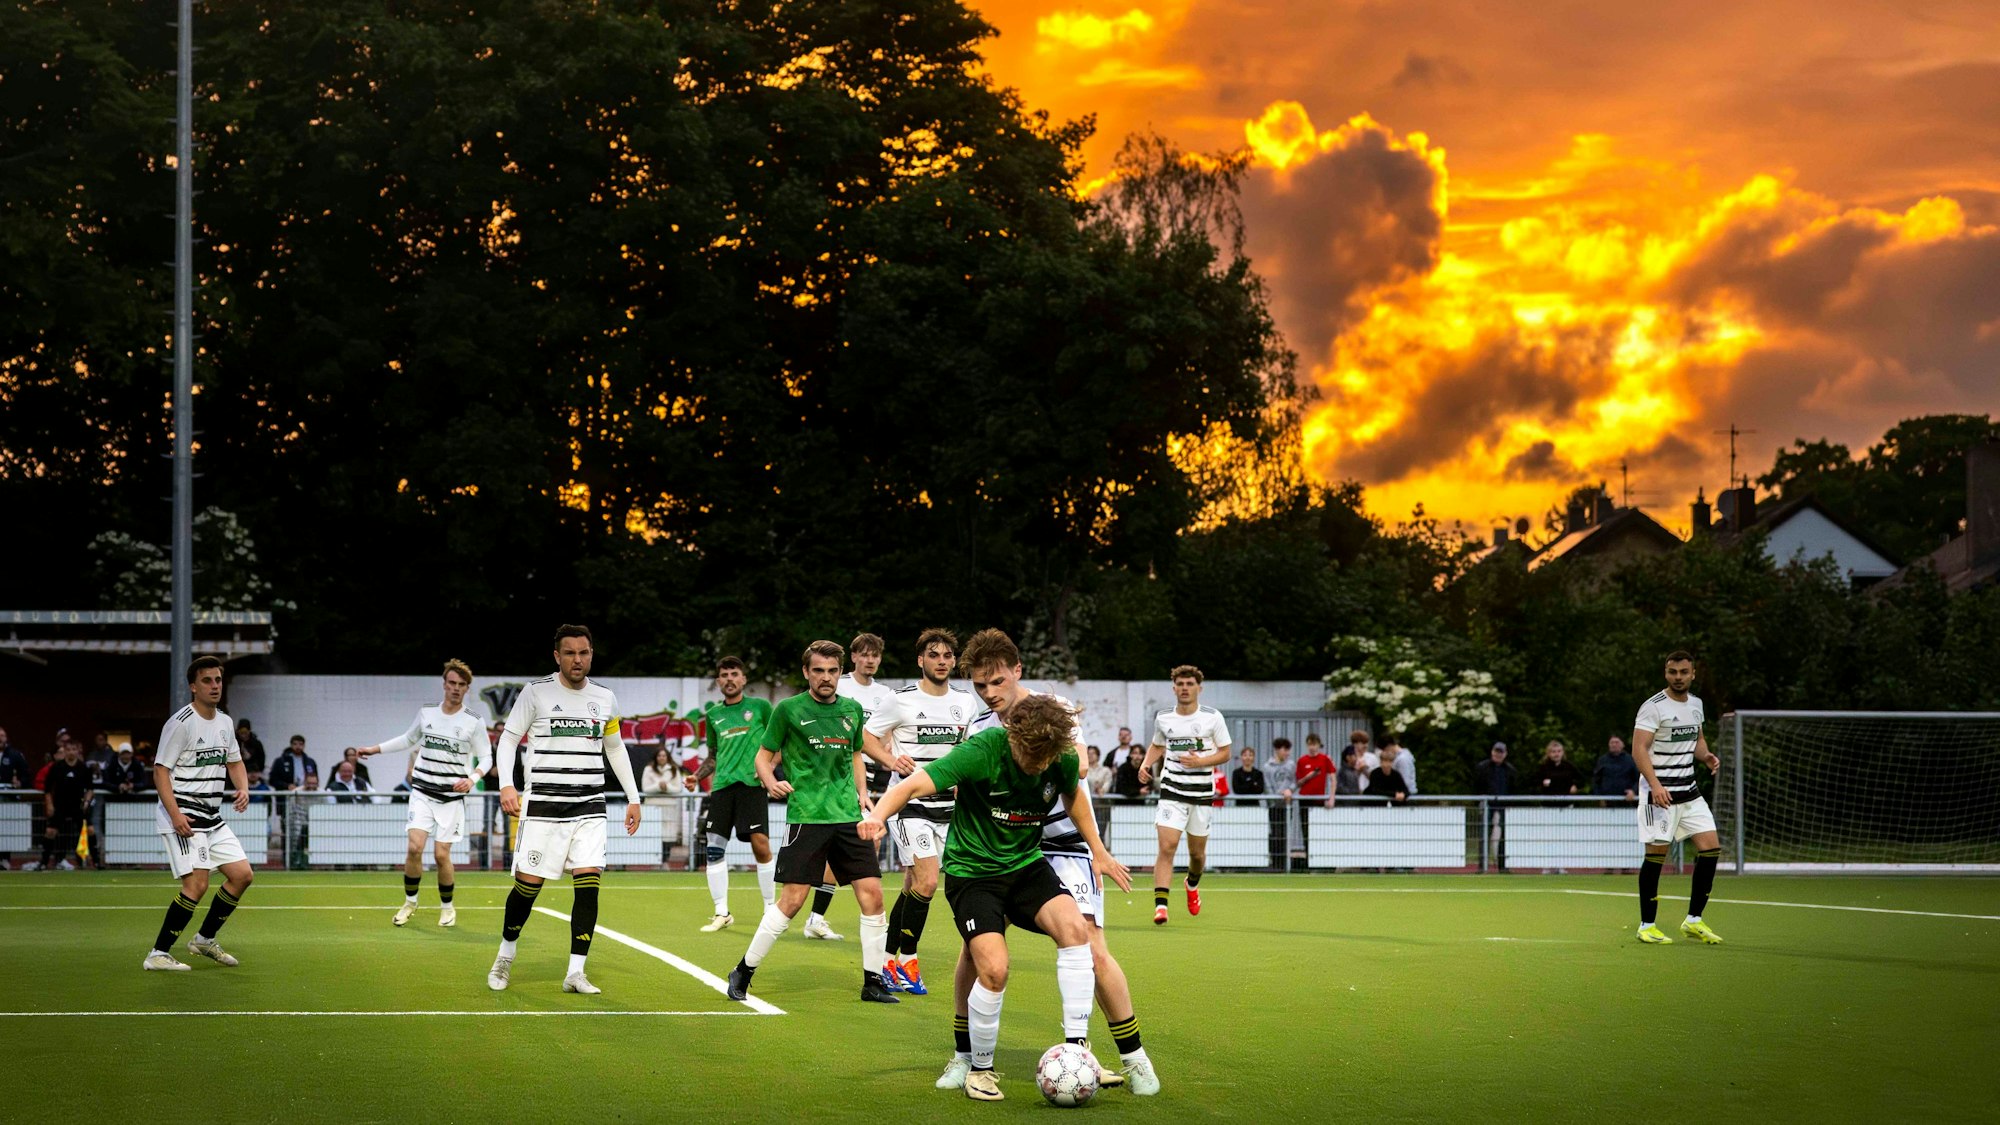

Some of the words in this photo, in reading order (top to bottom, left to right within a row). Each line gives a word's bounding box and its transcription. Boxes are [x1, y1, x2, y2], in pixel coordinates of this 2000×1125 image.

[991, 810, 1010, 820] TAXI
[1073, 882, 1089, 895] 20
[965, 918, 976, 932] 11
